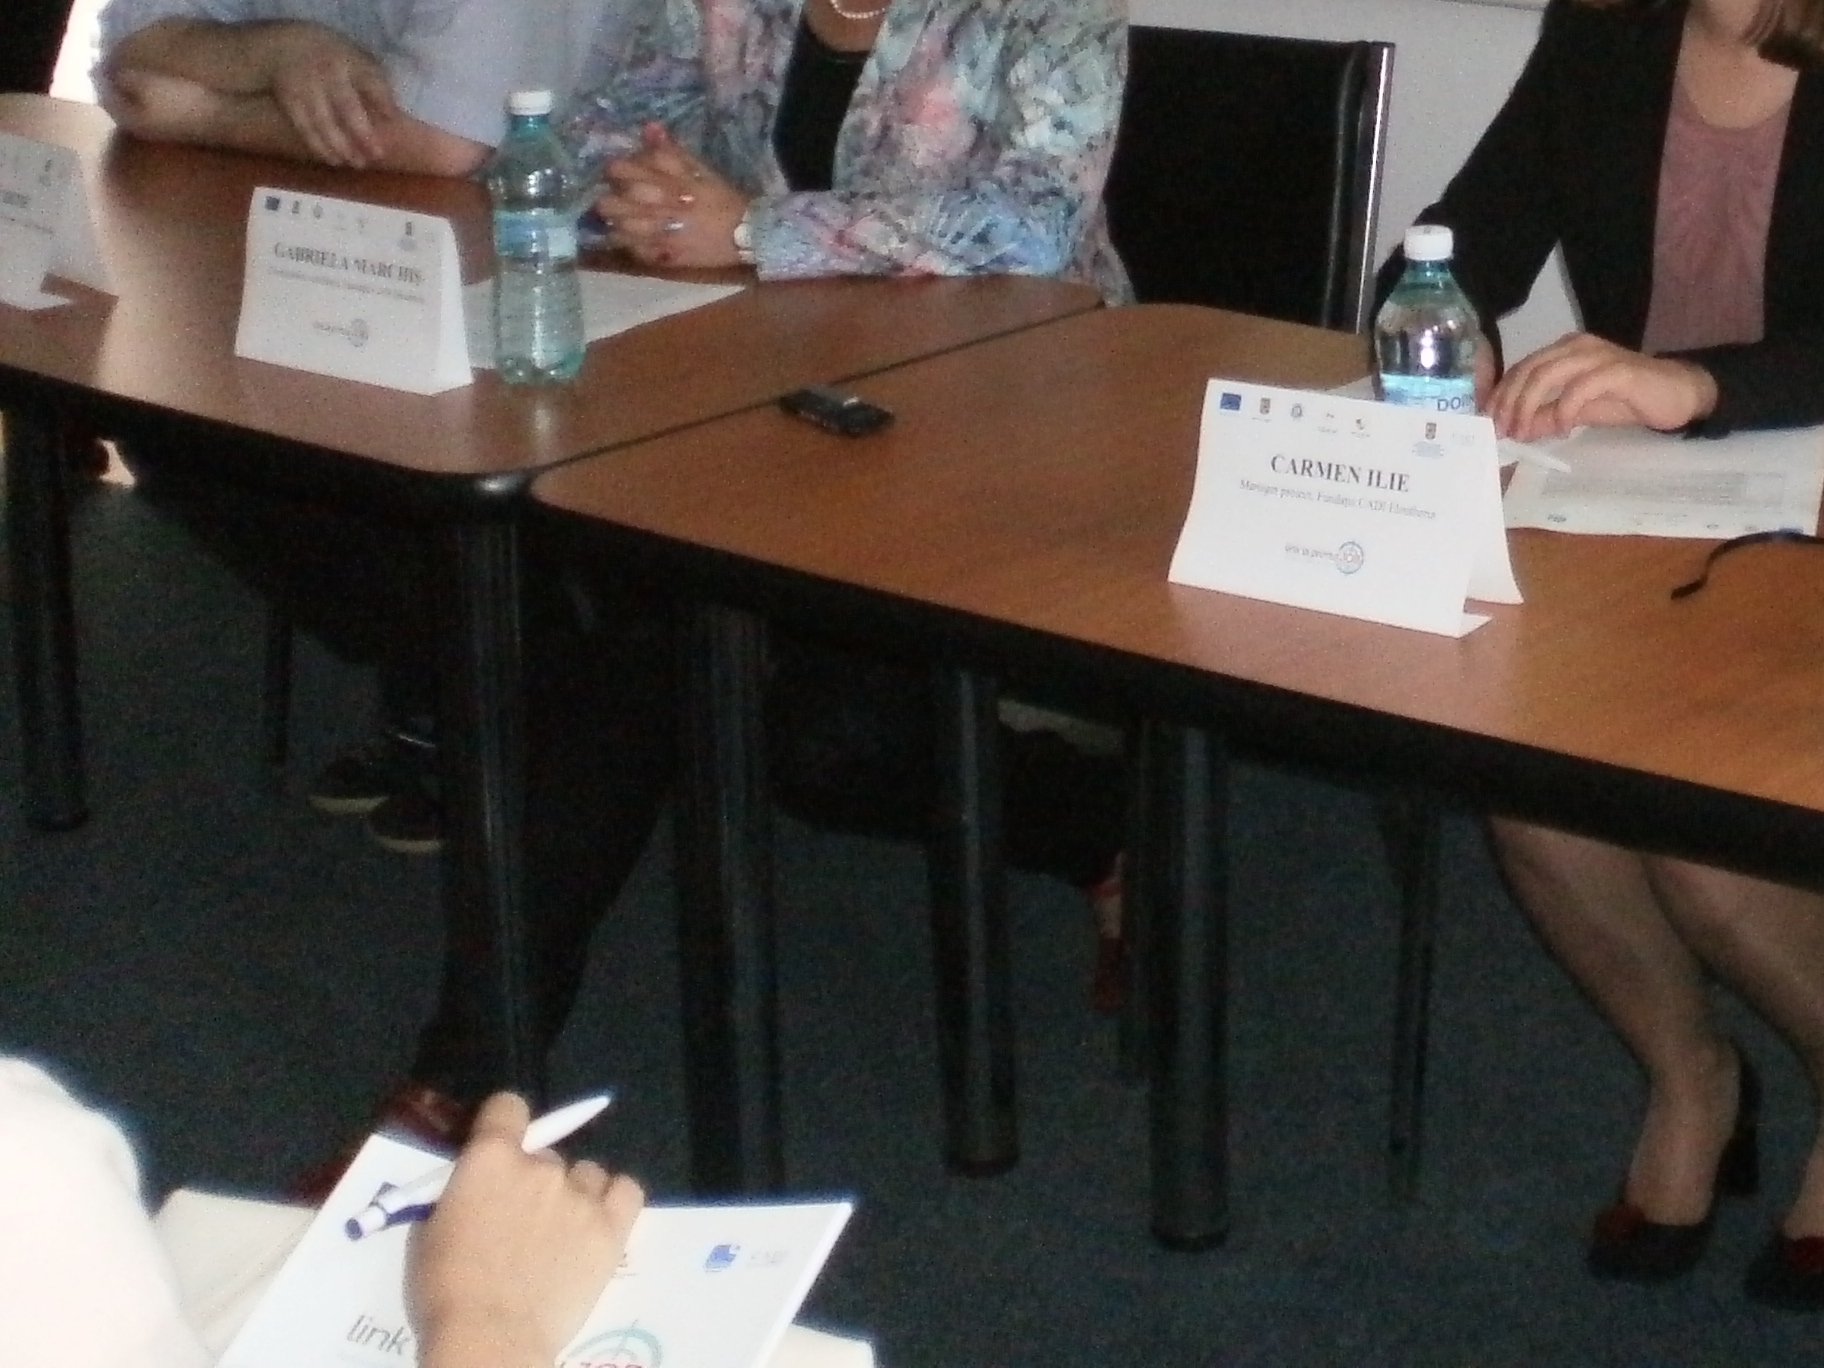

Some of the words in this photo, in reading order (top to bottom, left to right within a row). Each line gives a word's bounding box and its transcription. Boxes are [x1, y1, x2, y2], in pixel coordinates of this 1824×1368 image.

[273, 241, 349, 270] GABRIELA
[1270, 452, 1361, 485] CARMEN
[1366, 468, 1411, 493] ILIE
[346, 1313, 411, 1356] link
